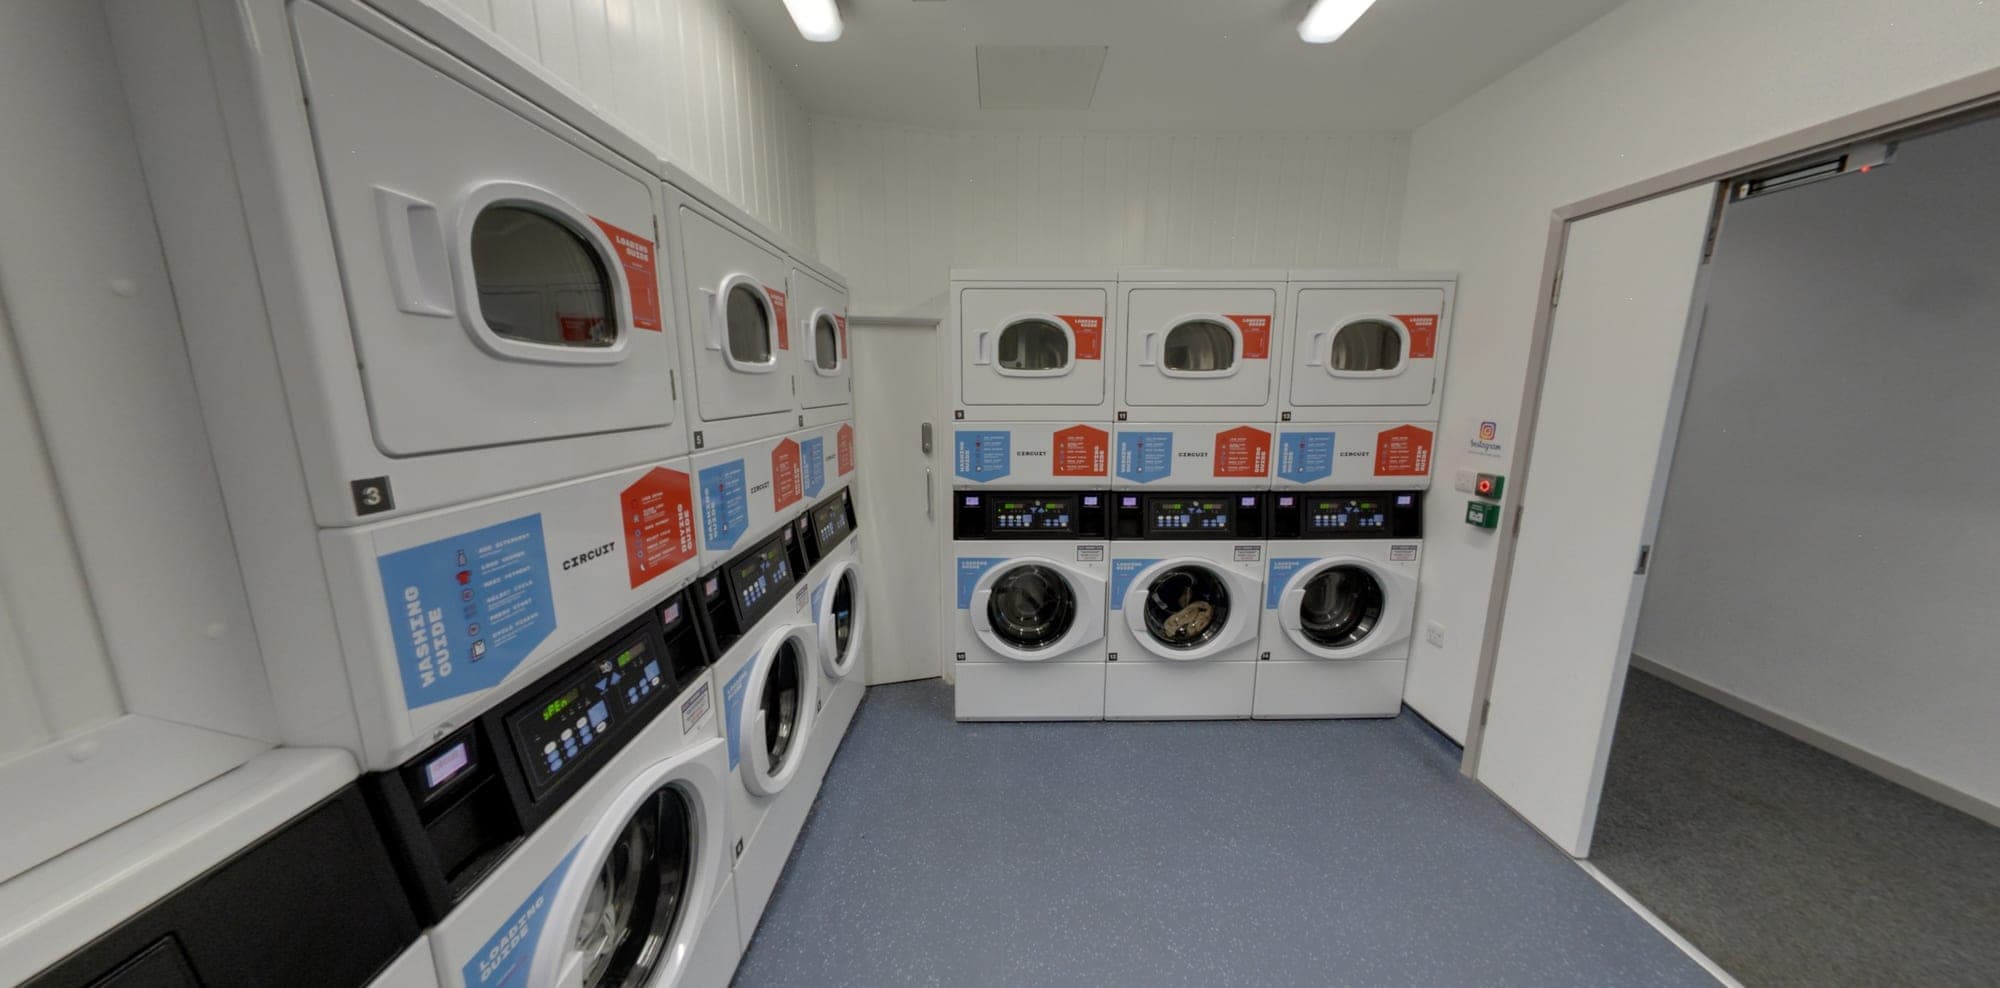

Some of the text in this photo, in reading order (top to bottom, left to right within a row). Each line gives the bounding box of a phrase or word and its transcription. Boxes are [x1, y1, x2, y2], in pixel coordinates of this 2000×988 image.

[615, 235, 648, 254] LOADING
[626, 247, 649, 262] GUIDE
[1470, 439, 1502, 452] Instagram
[363, 486, 381, 506] 3
[677, 503, 687, 553] DRYING
[683, 509, 693, 550] GUIDE
[562, 541, 616, 571] CIRCUIT
[404, 586, 436, 688] WASHING
[428, 607, 452, 677] GUIDE
[480, 896, 544, 971] LOADING
[481, 924, 528, 982] GUIDE
